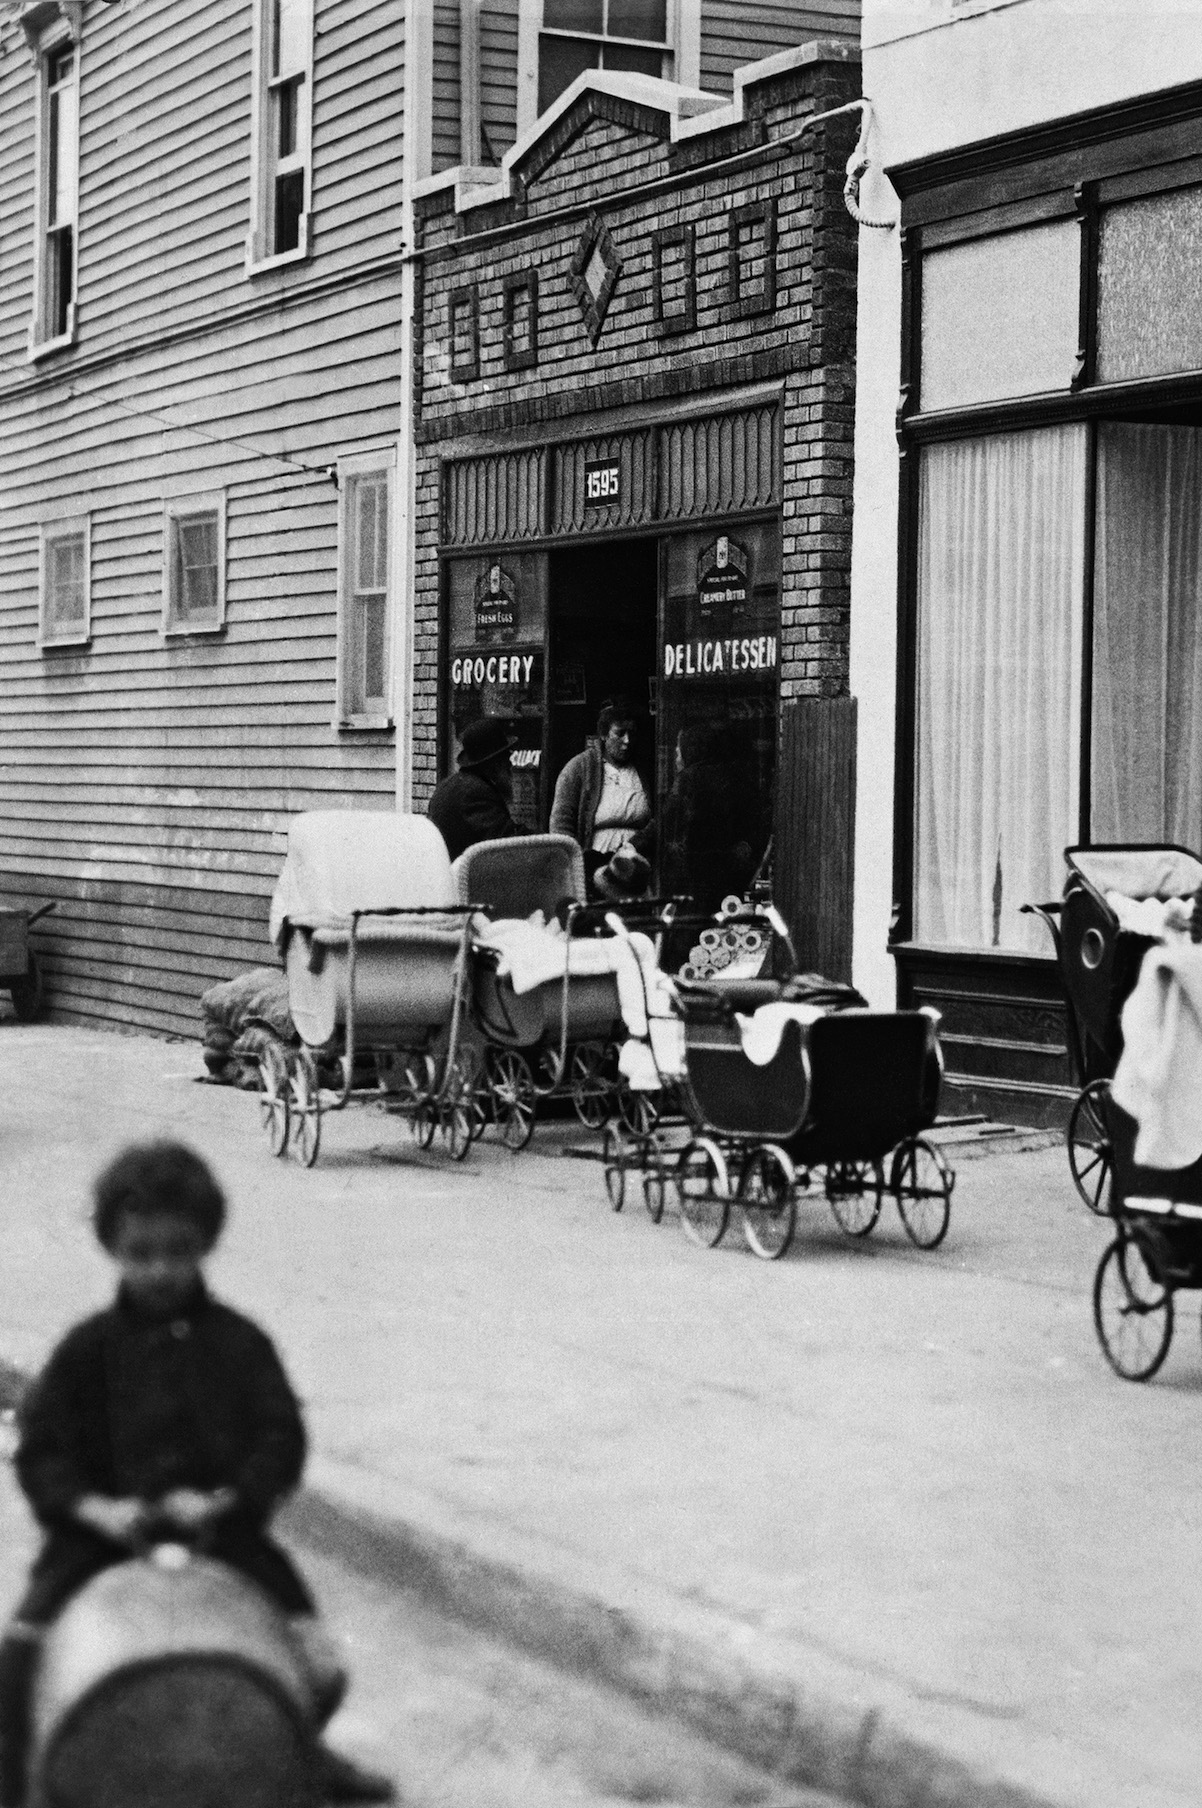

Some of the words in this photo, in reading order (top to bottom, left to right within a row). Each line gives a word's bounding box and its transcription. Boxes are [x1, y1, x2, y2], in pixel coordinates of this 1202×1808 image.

[587, 468, 619, 498] 1595
[452, 655, 534, 685] GROCERY
[664, 636, 777, 676] DELICATESSEN
